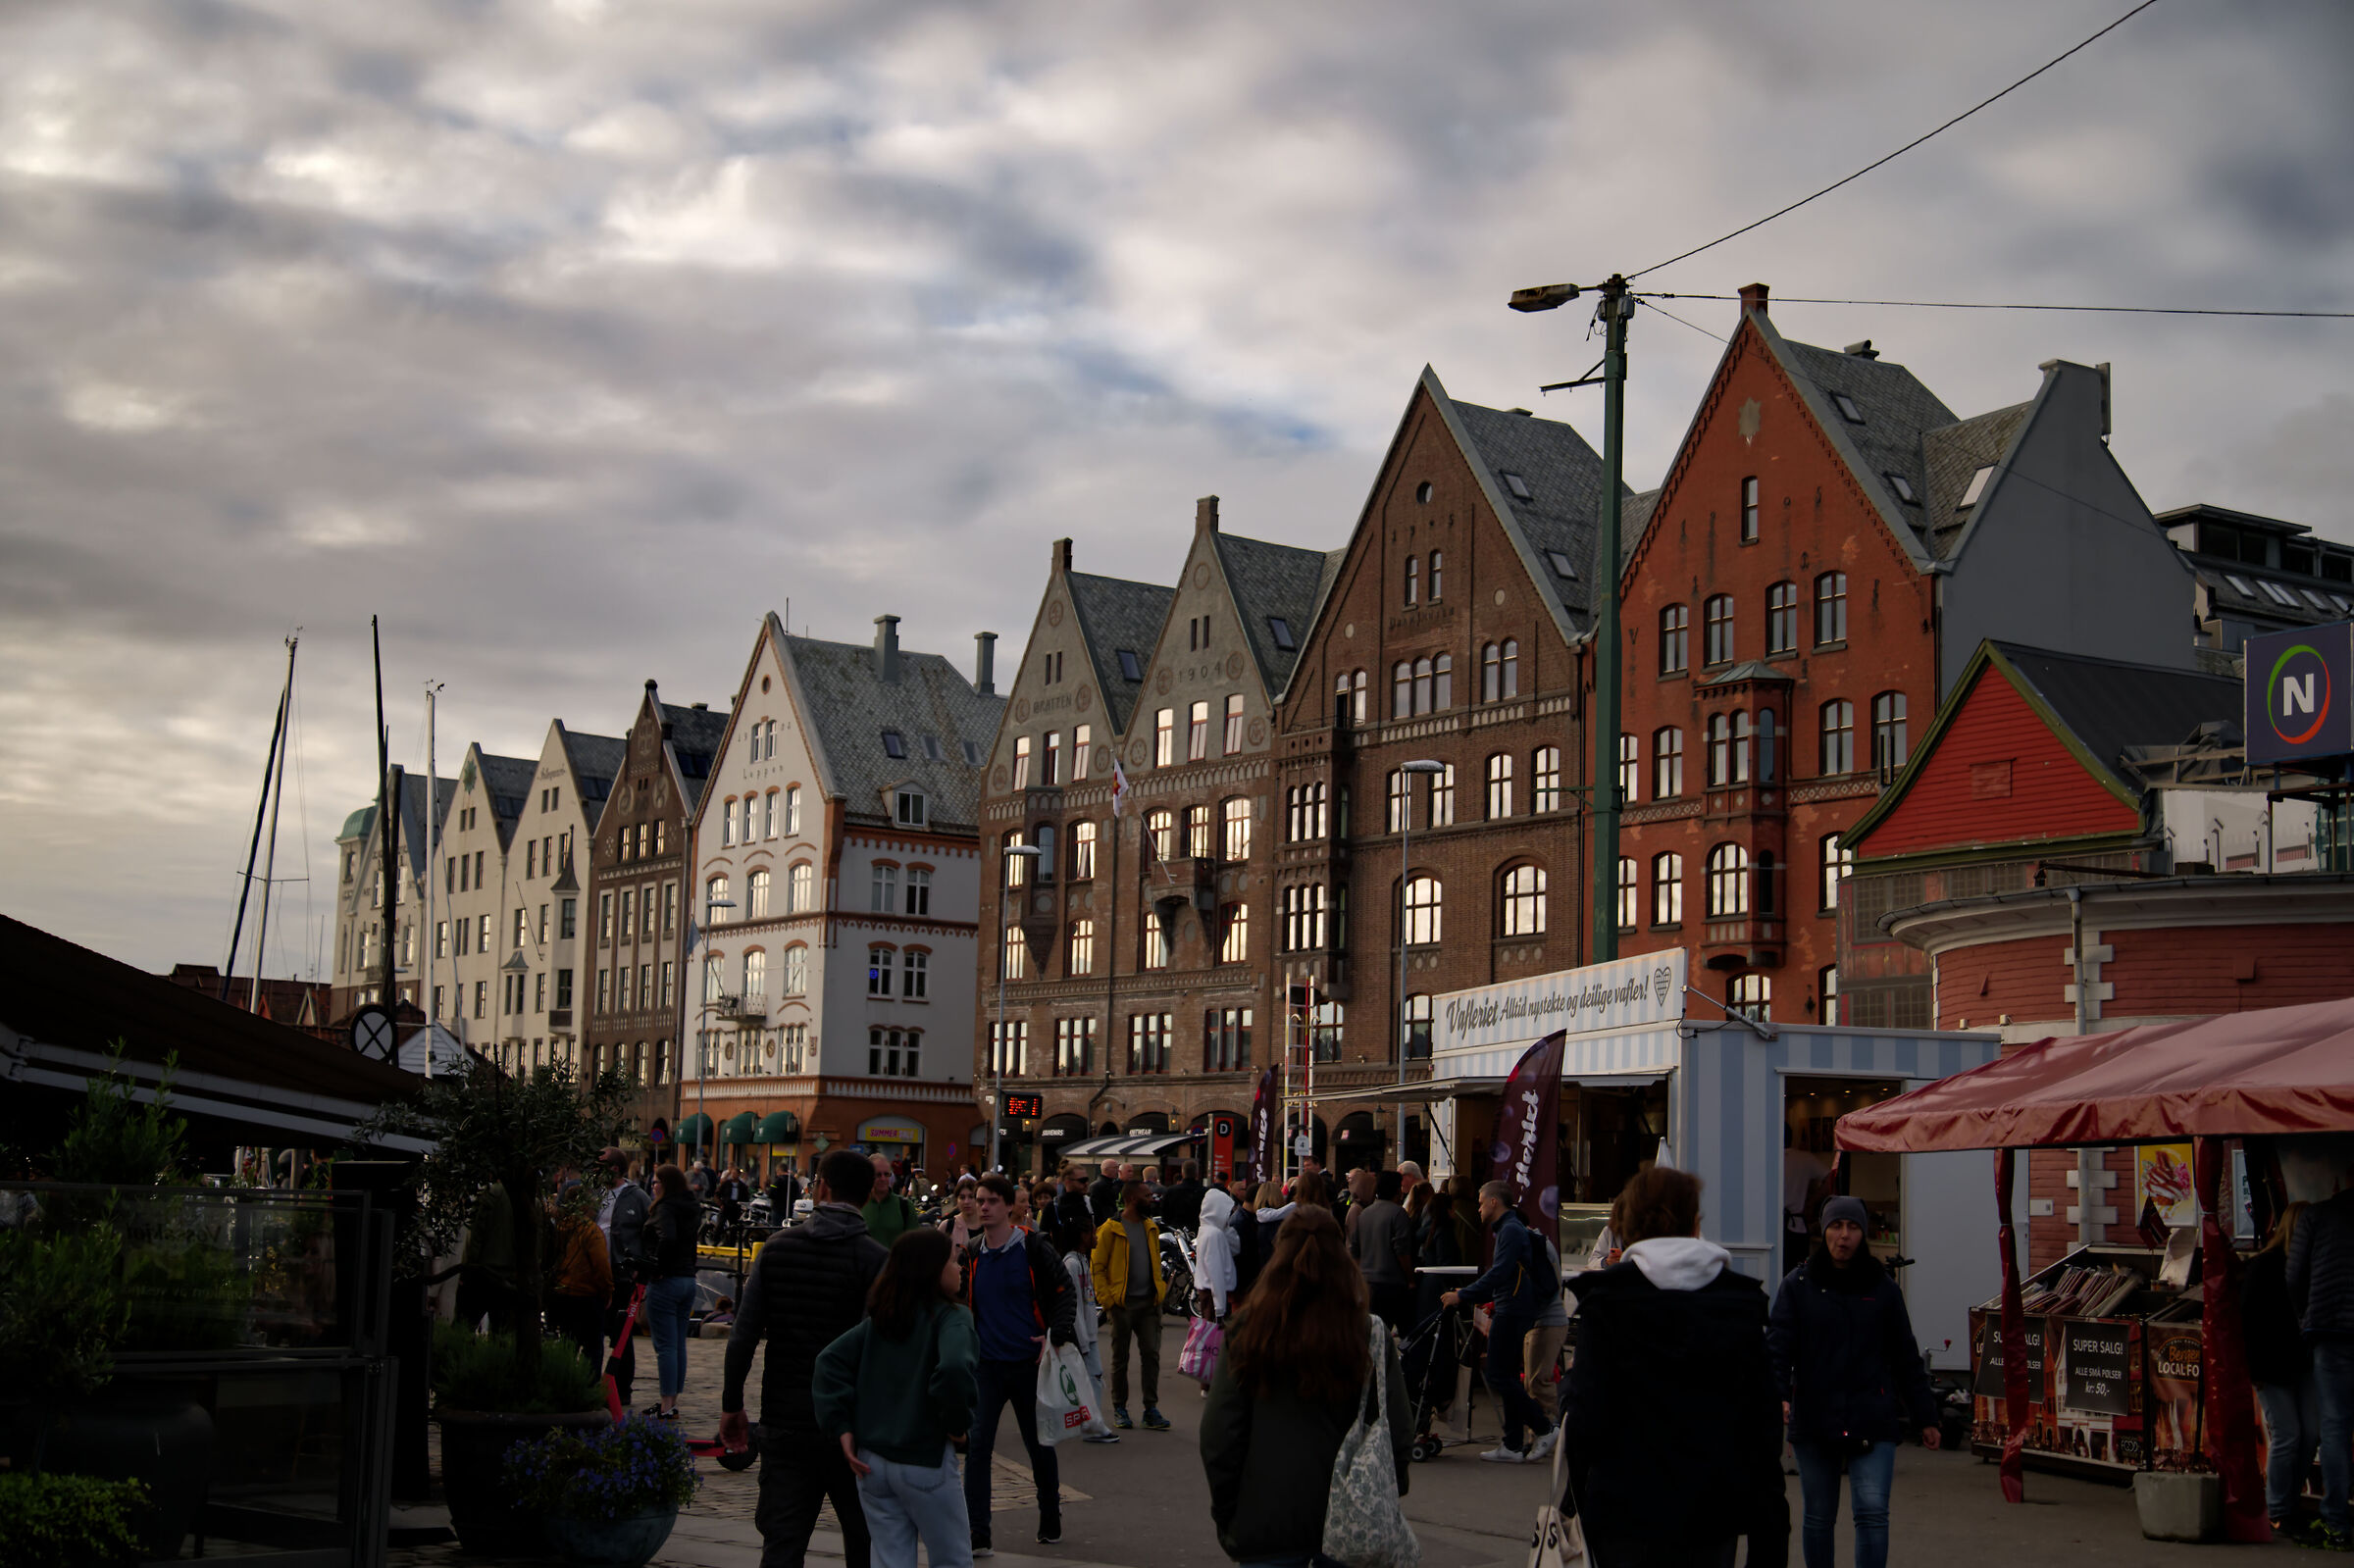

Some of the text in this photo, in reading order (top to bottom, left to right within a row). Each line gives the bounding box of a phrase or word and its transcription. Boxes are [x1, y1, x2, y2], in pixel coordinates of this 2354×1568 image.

[2282, 673, 2315, 717] N
[1446, 975, 1650, 1040] Vafleriet Alltid nystekte og deilige vafler!
[2073, 1339, 2124, 1355] SUPER SALG!
[2074, 1366, 2088, 1376] ALLE
[2158, 1361, 2200, 1378] LOCAL FO
